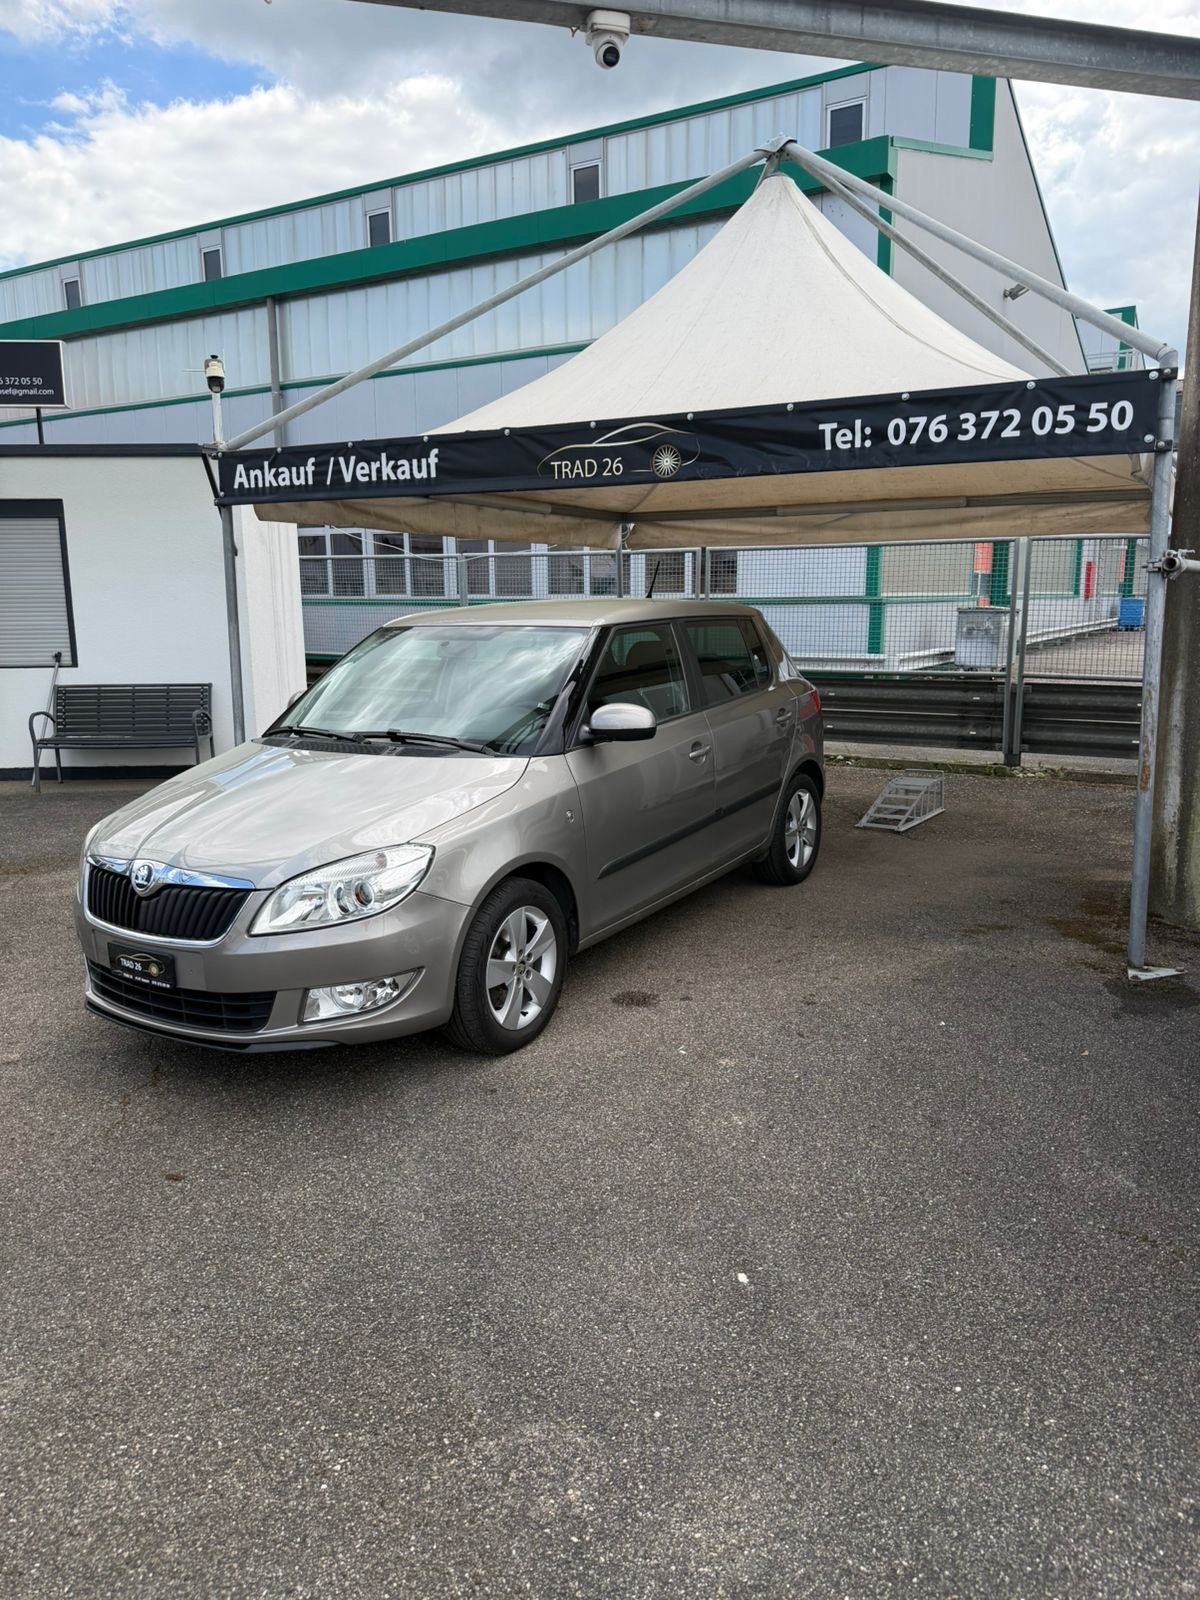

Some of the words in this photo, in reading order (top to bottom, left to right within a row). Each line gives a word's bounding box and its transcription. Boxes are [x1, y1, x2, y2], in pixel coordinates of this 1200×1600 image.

[5, 377, 19, 385] 372
[21, 377, 31, 385] 05
[32, 377, 42, 385] 50
[818, 419, 873, 451] Tel:
[887, 415, 949, 446] 076
[957, 408, 1022, 441] 372
[1031, 404, 1076, 436] 05
[1087, 400, 1134, 432] 50
[234, 457, 315, 489] Ankauf
[550, 459, 598, 480] TRAD
[602, 457, 624, 476] 26
[134, 962, 142, 971] 26
